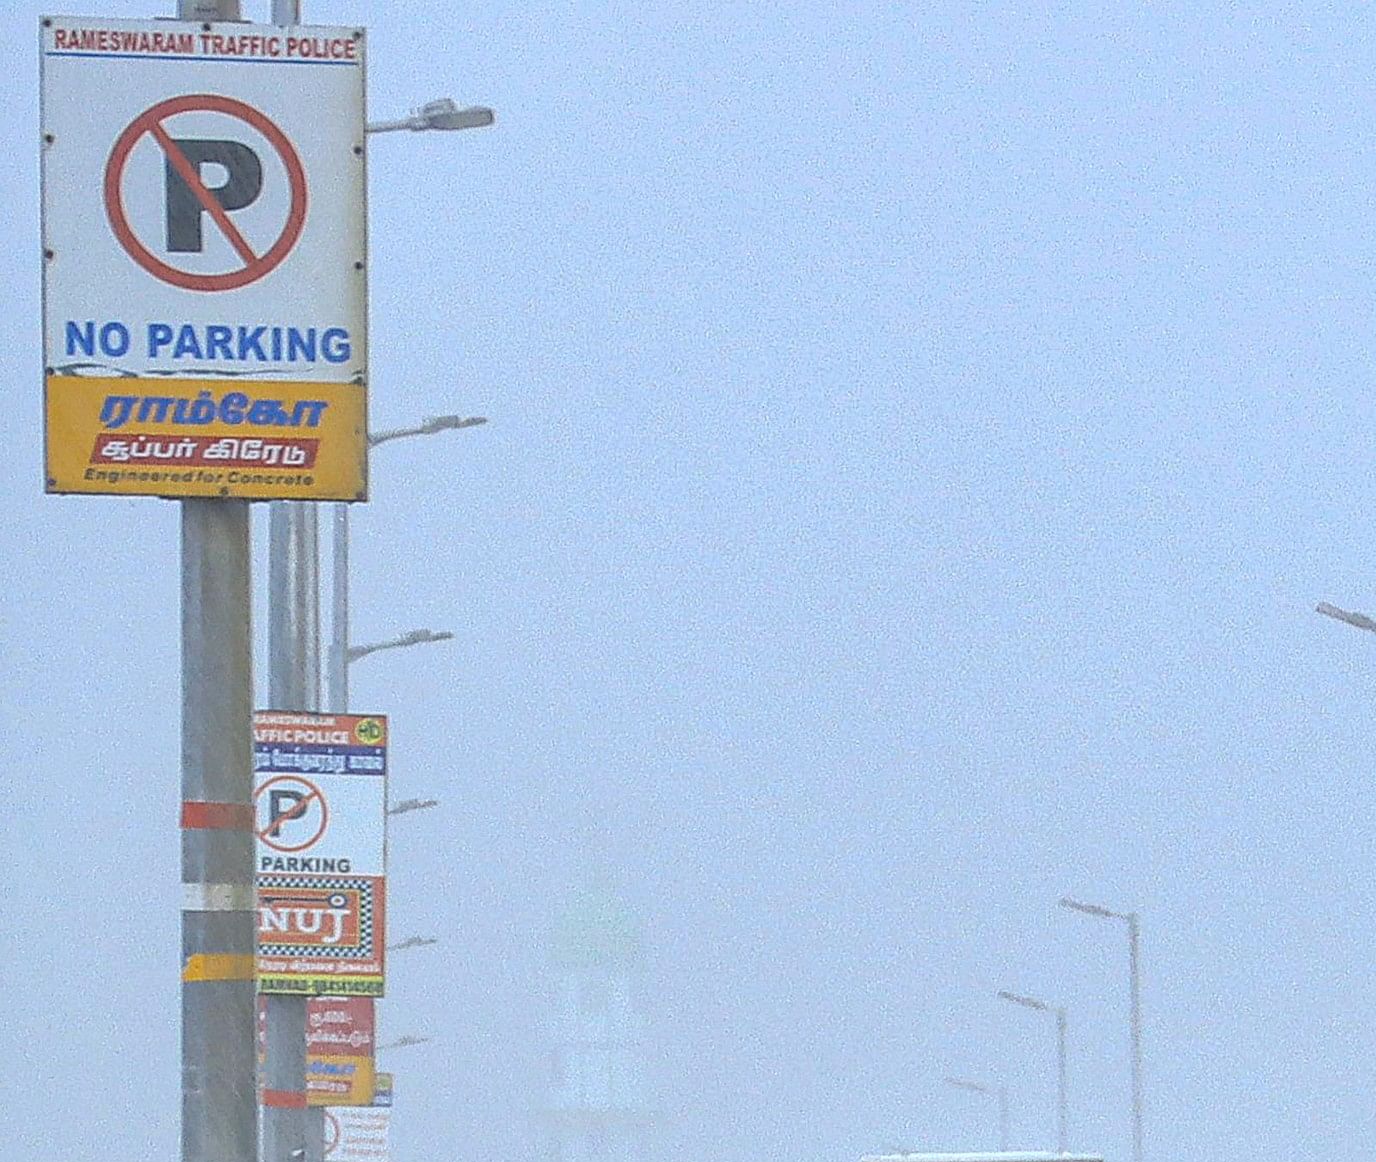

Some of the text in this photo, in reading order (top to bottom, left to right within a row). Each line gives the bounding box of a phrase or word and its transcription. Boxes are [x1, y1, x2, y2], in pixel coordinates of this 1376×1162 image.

[54, 29, 355, 59] RAMESWARAM TRAFFIC POLICE
[65, 321, 351, 363] NO PARKING
[294, 730, 349, 745] POLICE
[262, 857, 350, 873] PARKING
[258, 907, 351, 943] NUJ
